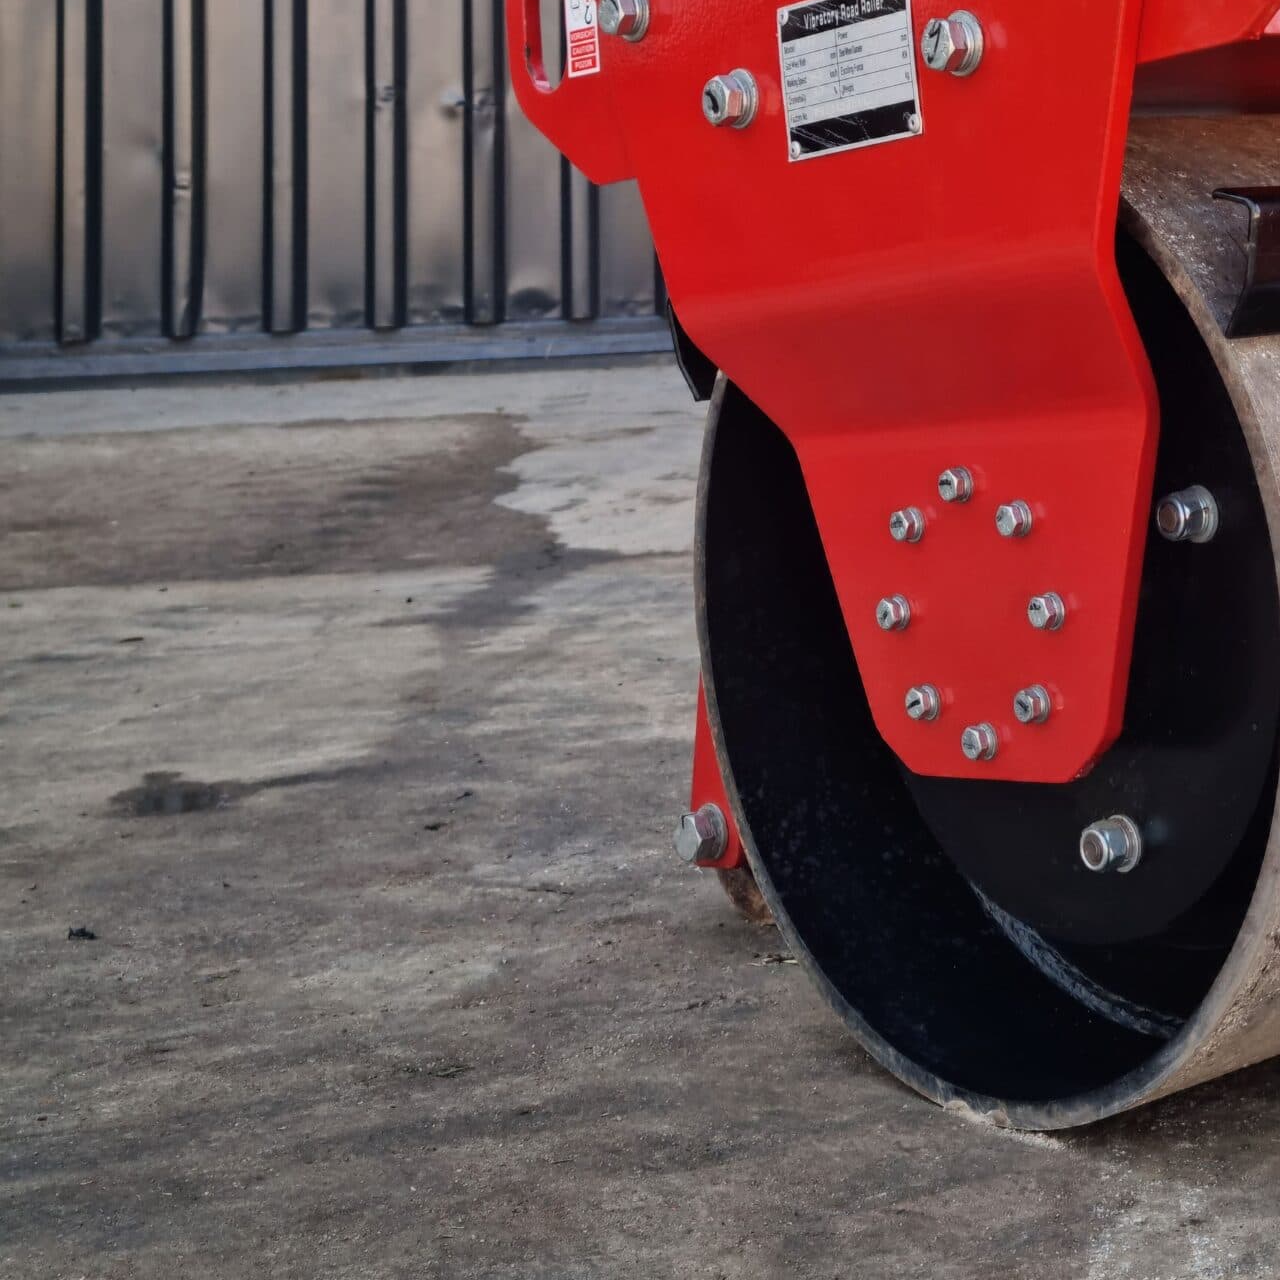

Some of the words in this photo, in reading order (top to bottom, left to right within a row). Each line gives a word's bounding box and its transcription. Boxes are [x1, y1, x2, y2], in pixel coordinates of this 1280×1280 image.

[803, 10, 839, 29] Vibratory
[840, 0, 859, 19] Road
[571, 30, 595, 41] VORSICHT
[572, 44, 594, 55] CAUTION
